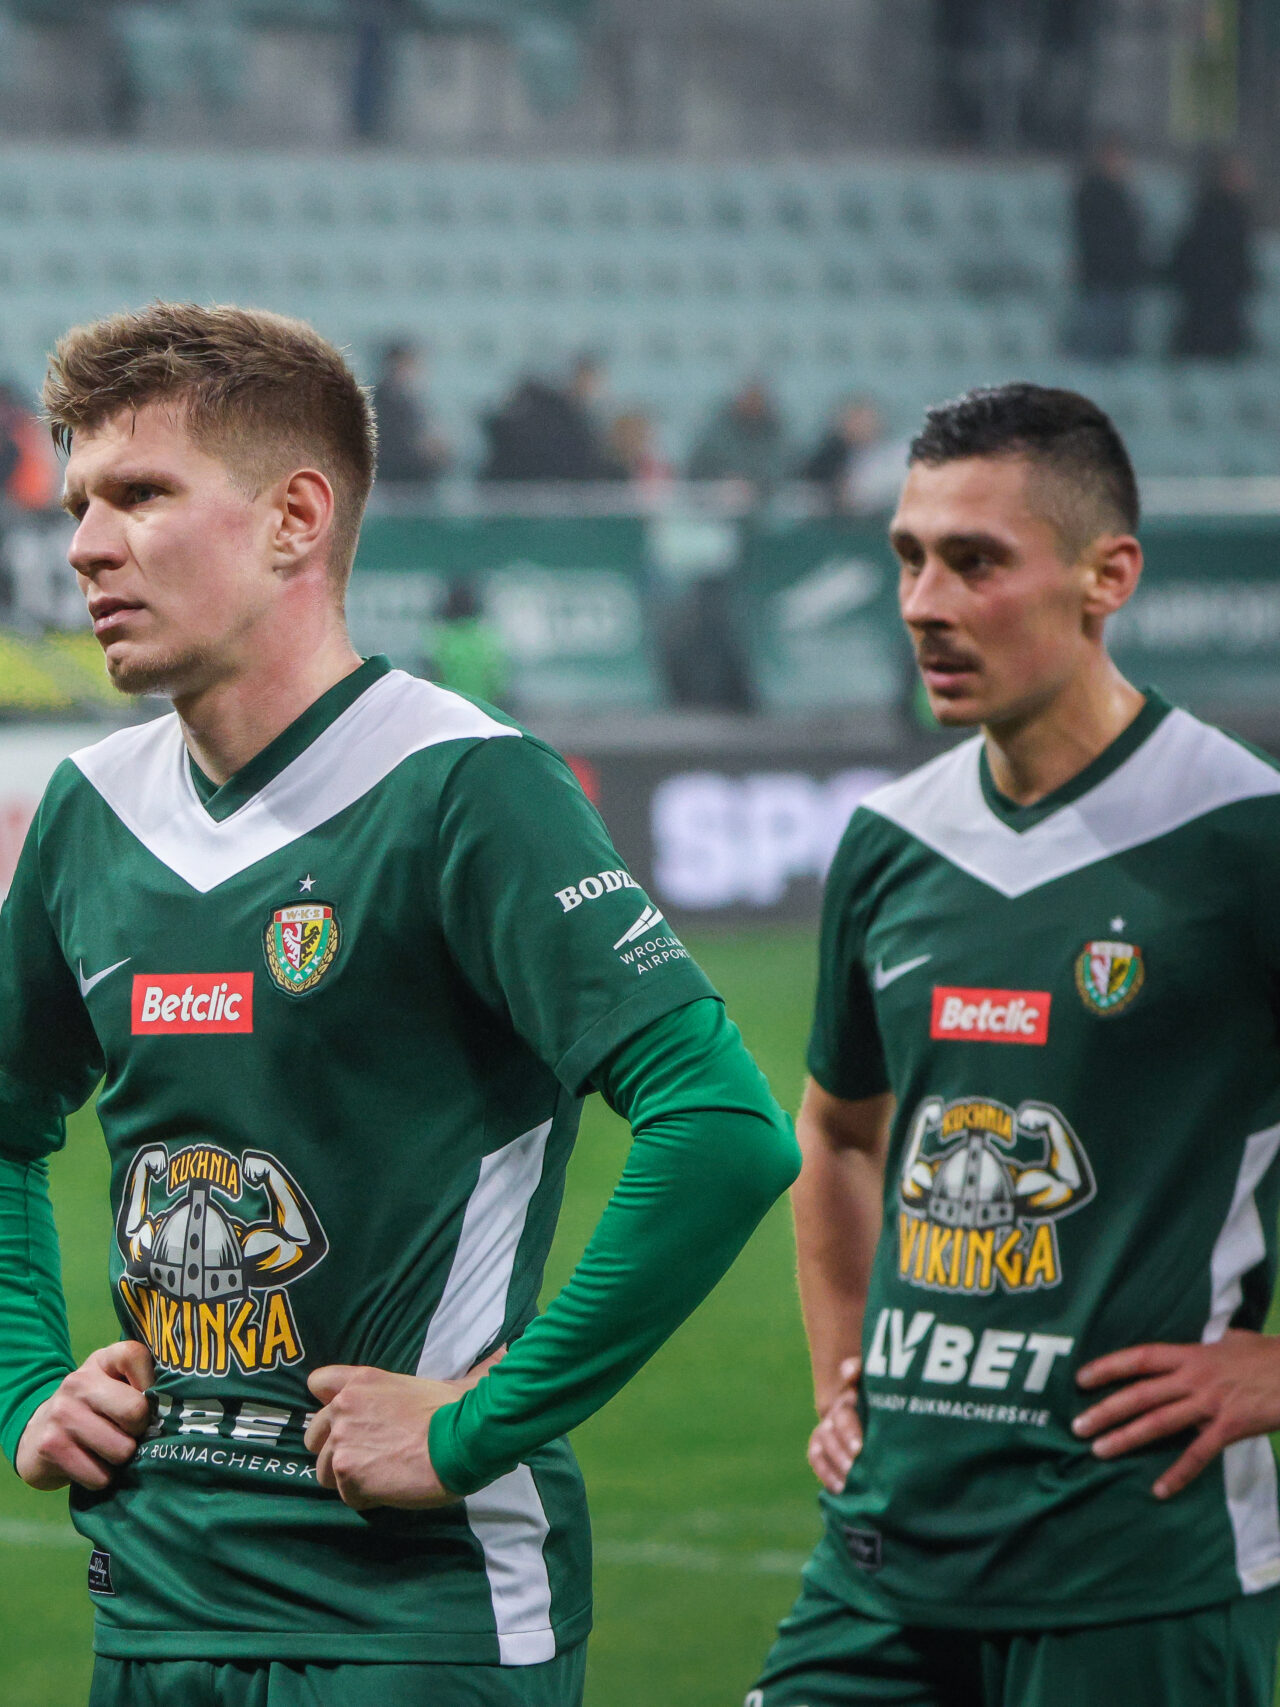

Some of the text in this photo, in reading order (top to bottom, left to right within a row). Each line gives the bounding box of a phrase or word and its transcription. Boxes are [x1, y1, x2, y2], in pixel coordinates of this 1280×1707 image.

[554, 869, 642, 913] BODZ
[141, 982, 243, 1022] Betclic
[939, 996, 1040, 1035] Betclic
[170, 1150, 238, 1195] KUCHNIA
[899, 1213, 1056, 1289] VIKINGA
[121, 1280, 298, 1370] VIKINGA
[150, 1444, 317, 1479] BUKMACHERSK
